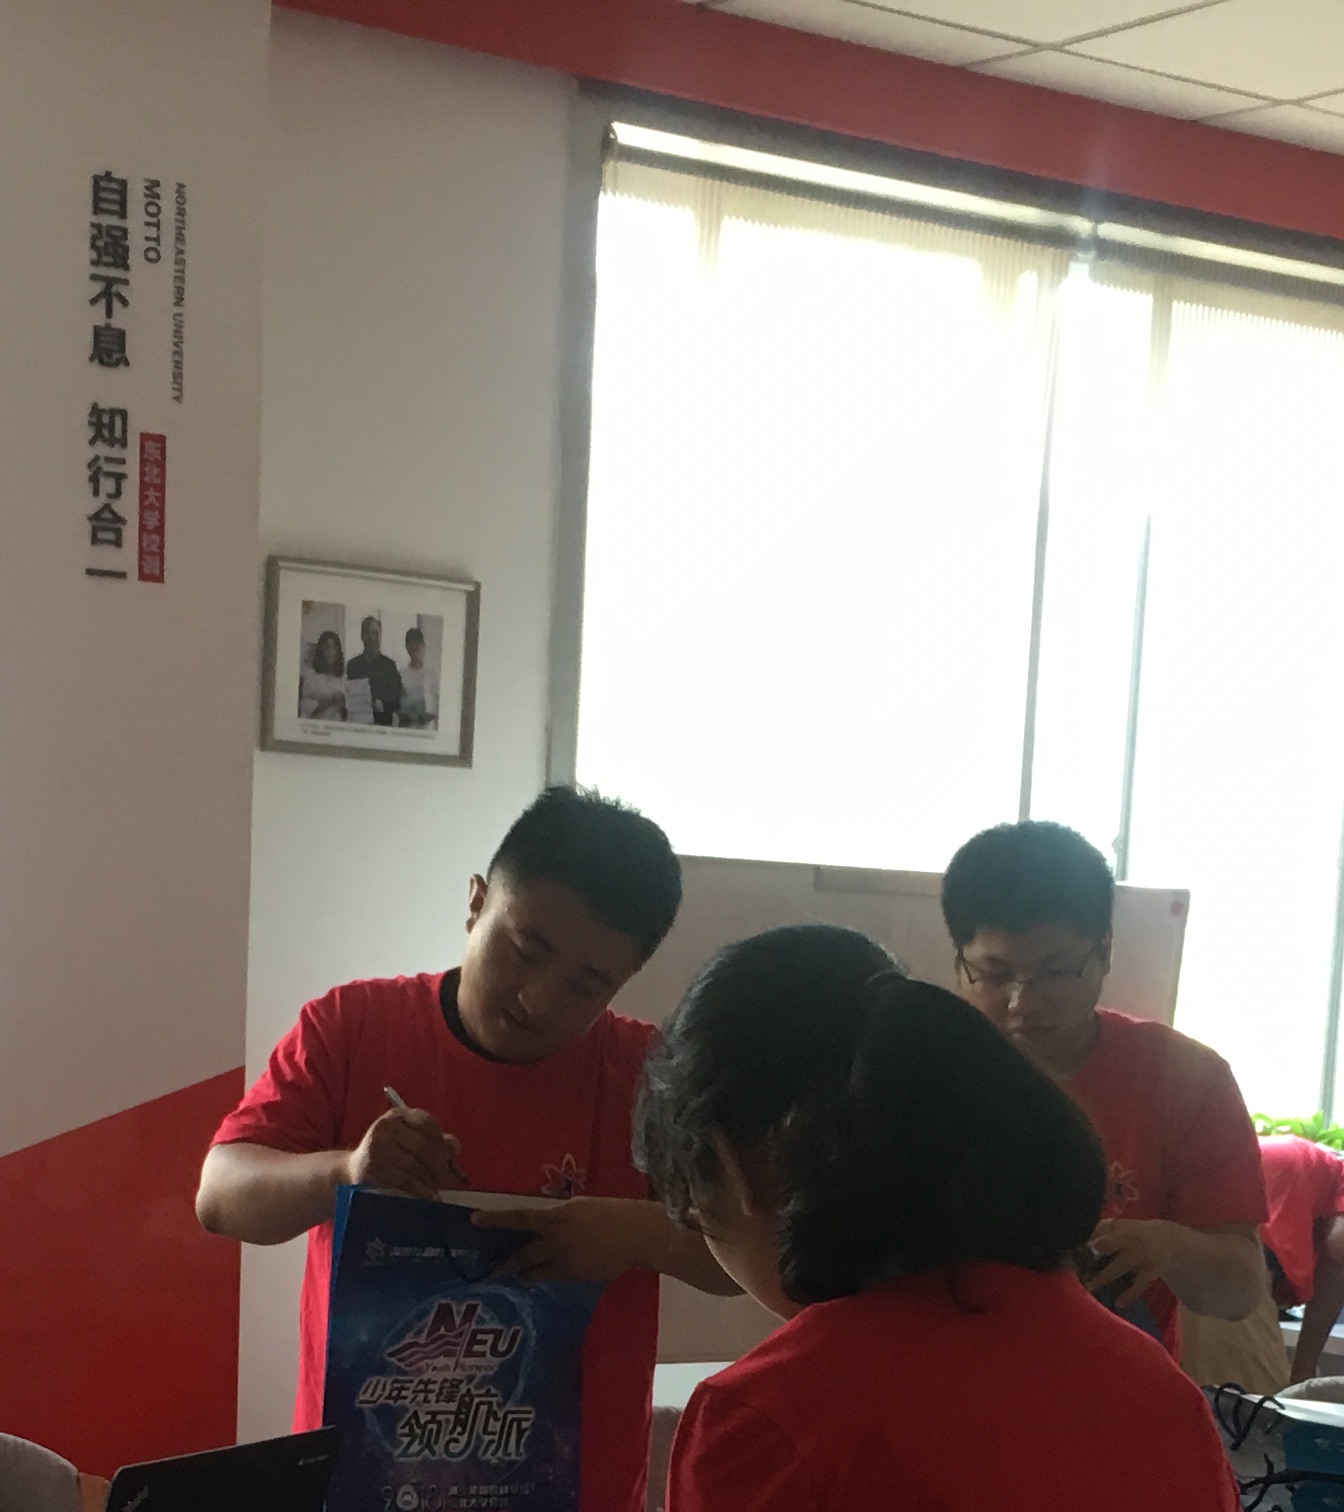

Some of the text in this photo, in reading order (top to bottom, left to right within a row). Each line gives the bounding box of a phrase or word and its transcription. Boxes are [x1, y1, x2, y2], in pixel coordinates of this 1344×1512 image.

[143, 177, 162, 265] MOTTO
[85, 170, 130, 580] 自强不息 知行合一
[359, 1377, 465, 1405] 少年先锋
